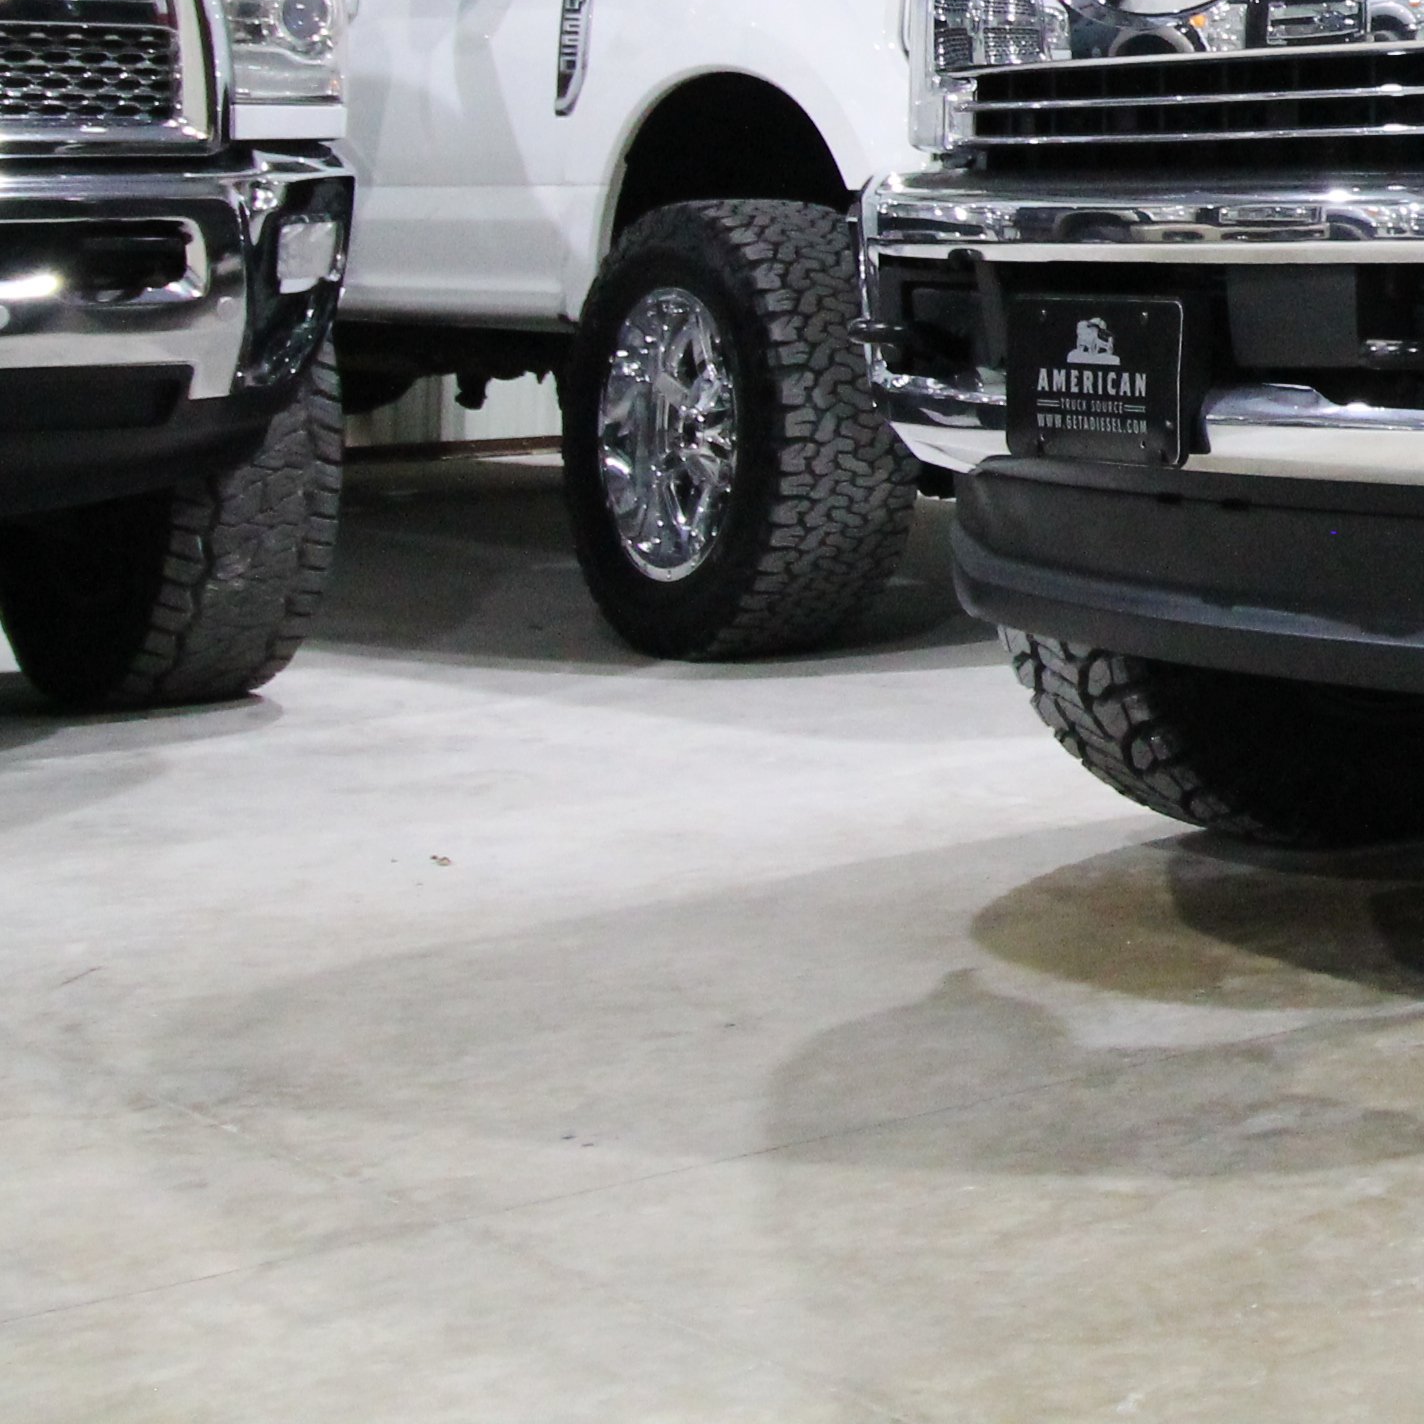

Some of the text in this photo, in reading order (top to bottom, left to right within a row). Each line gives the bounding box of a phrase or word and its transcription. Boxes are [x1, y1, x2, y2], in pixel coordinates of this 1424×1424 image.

[1037, 368, 1146, 397] AMERICAN
[1060, 398, 1123, 414] TRUCK SOURCE
[1037, 413, 1147, 434] WWW.GETADIESEL.COM
